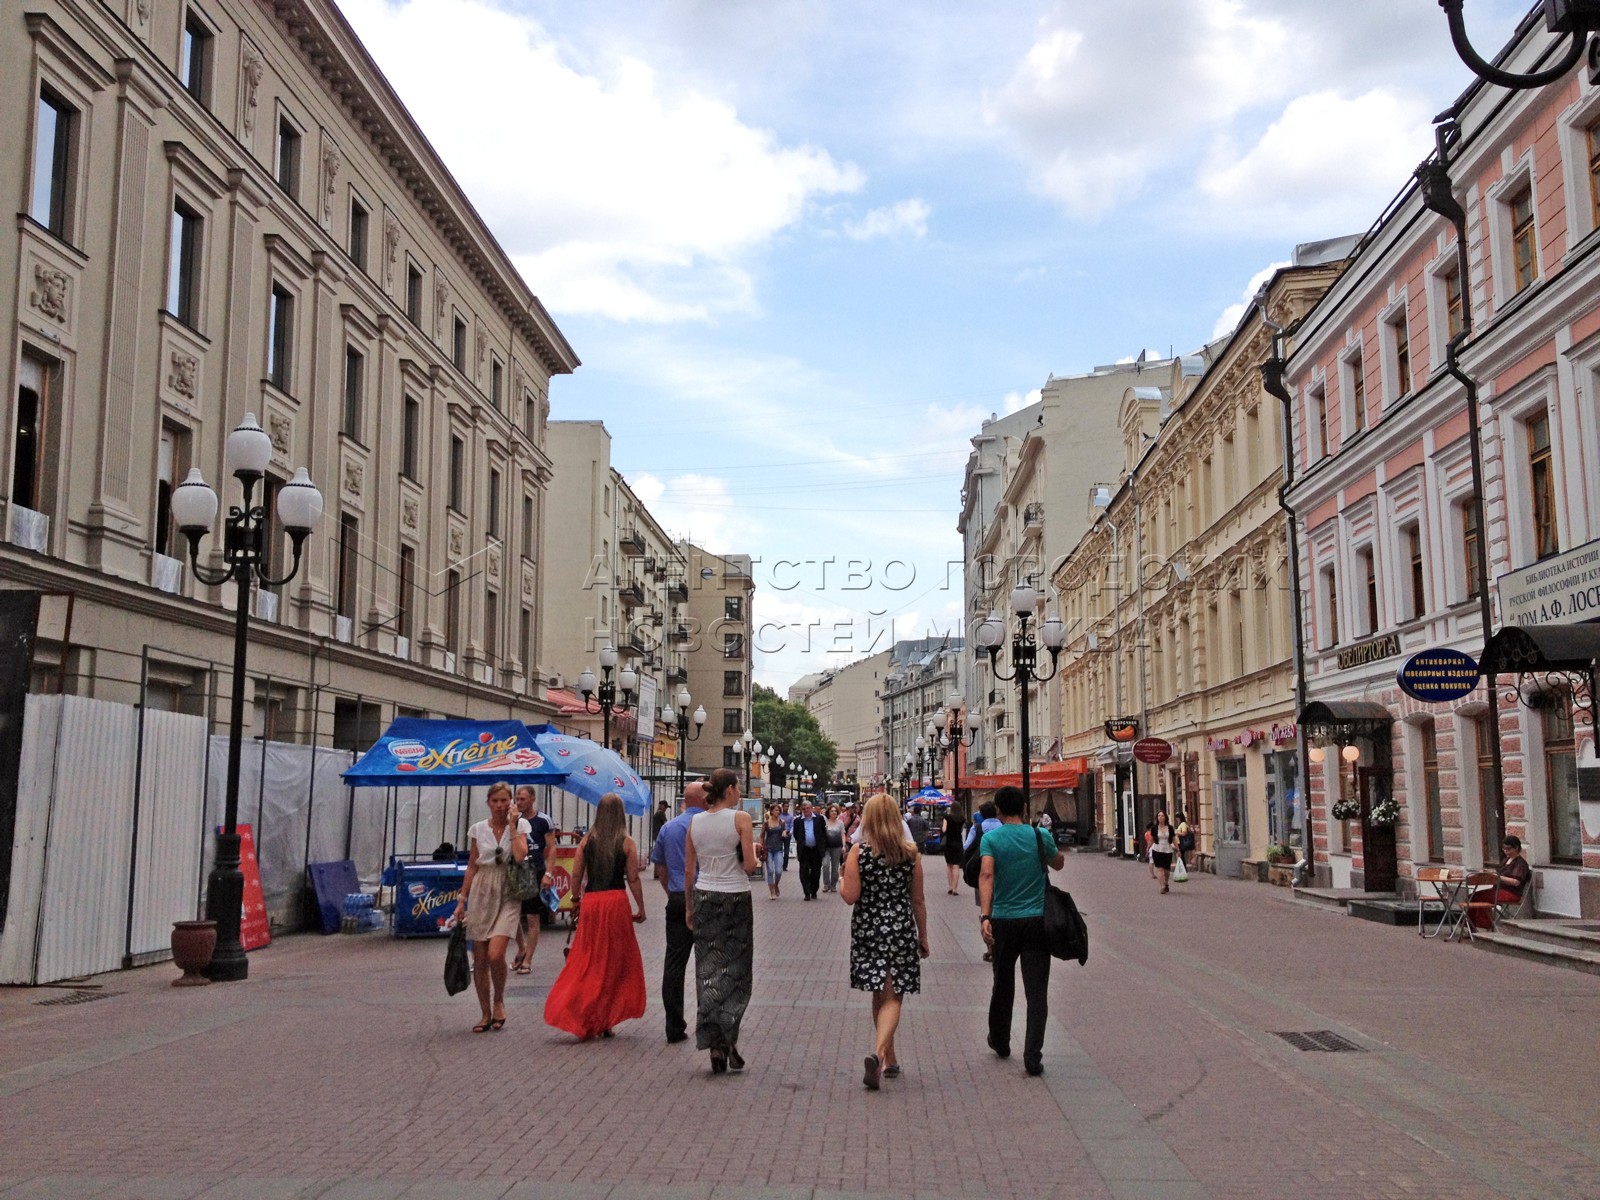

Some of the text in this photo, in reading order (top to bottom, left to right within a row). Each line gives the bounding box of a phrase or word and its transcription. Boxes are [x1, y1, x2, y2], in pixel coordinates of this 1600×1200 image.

[1525, 550, 1599, 586] БИБЛИОТЕКА ИСТОРИИ
[1509, 589, 1536, 608] РУССКОЙ
[1538, 574, 1580, 597] ФИЛОСОФИИ
[1581, 572, 1588, 583] И
[1415, 658, 1466, 666] АНТИКВАРИАТ
[1413, 682, 1471, 691] ОЦЕНКА ПОКУПКА
[411, 888, 463, 919] eXtrêm
